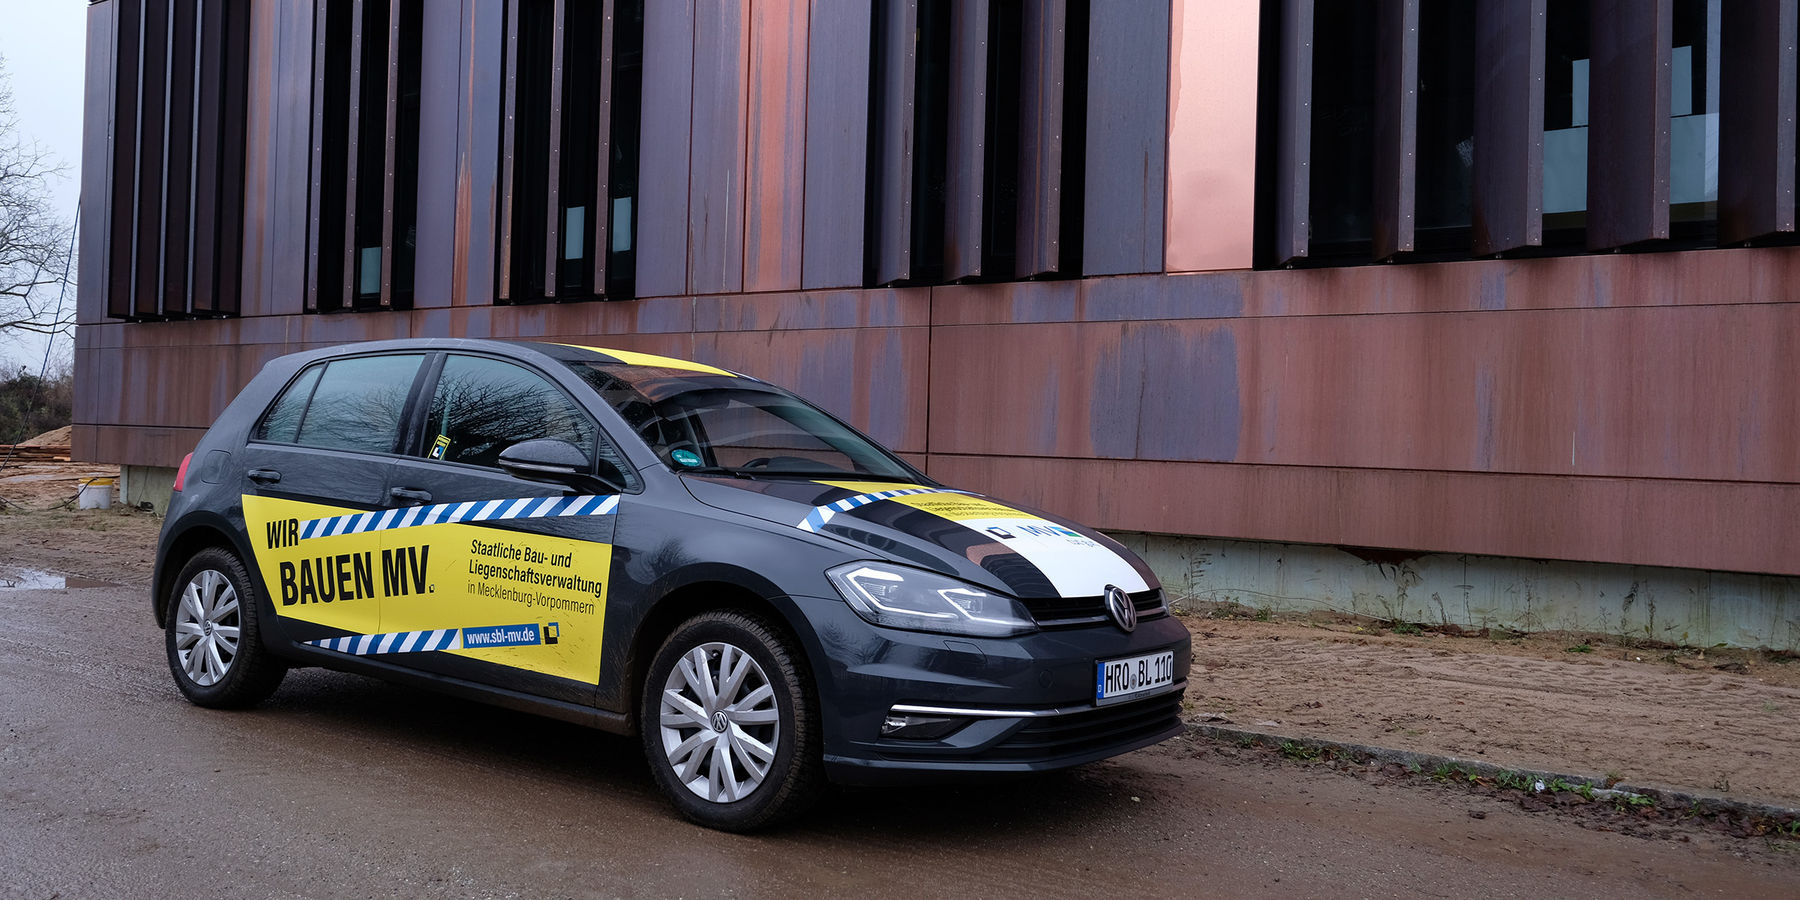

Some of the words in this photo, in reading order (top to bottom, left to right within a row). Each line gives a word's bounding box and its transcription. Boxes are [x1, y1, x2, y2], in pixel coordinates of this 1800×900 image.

[266, 518, 299, 549] WIR
[471, 539, 521, 561] Staatliche
[524, 547, 549, 565] Bau-
[551, 552, 573, 568] und
[280, 551, 375, 606] BAUEN
[469, 559, 602, 599] Liegenschaftsverwaltung
[467, 580, 476, 594] in
[477, 581, 595, 615] Mecklenburg-Vorpommern
[467, 627, 535, 645] www.sbl-mv.de
[1105, 662, 1129, 694] HRO
[1138, 660, 1152, 688] BL
[1155, 655, 1172, 684] 110
